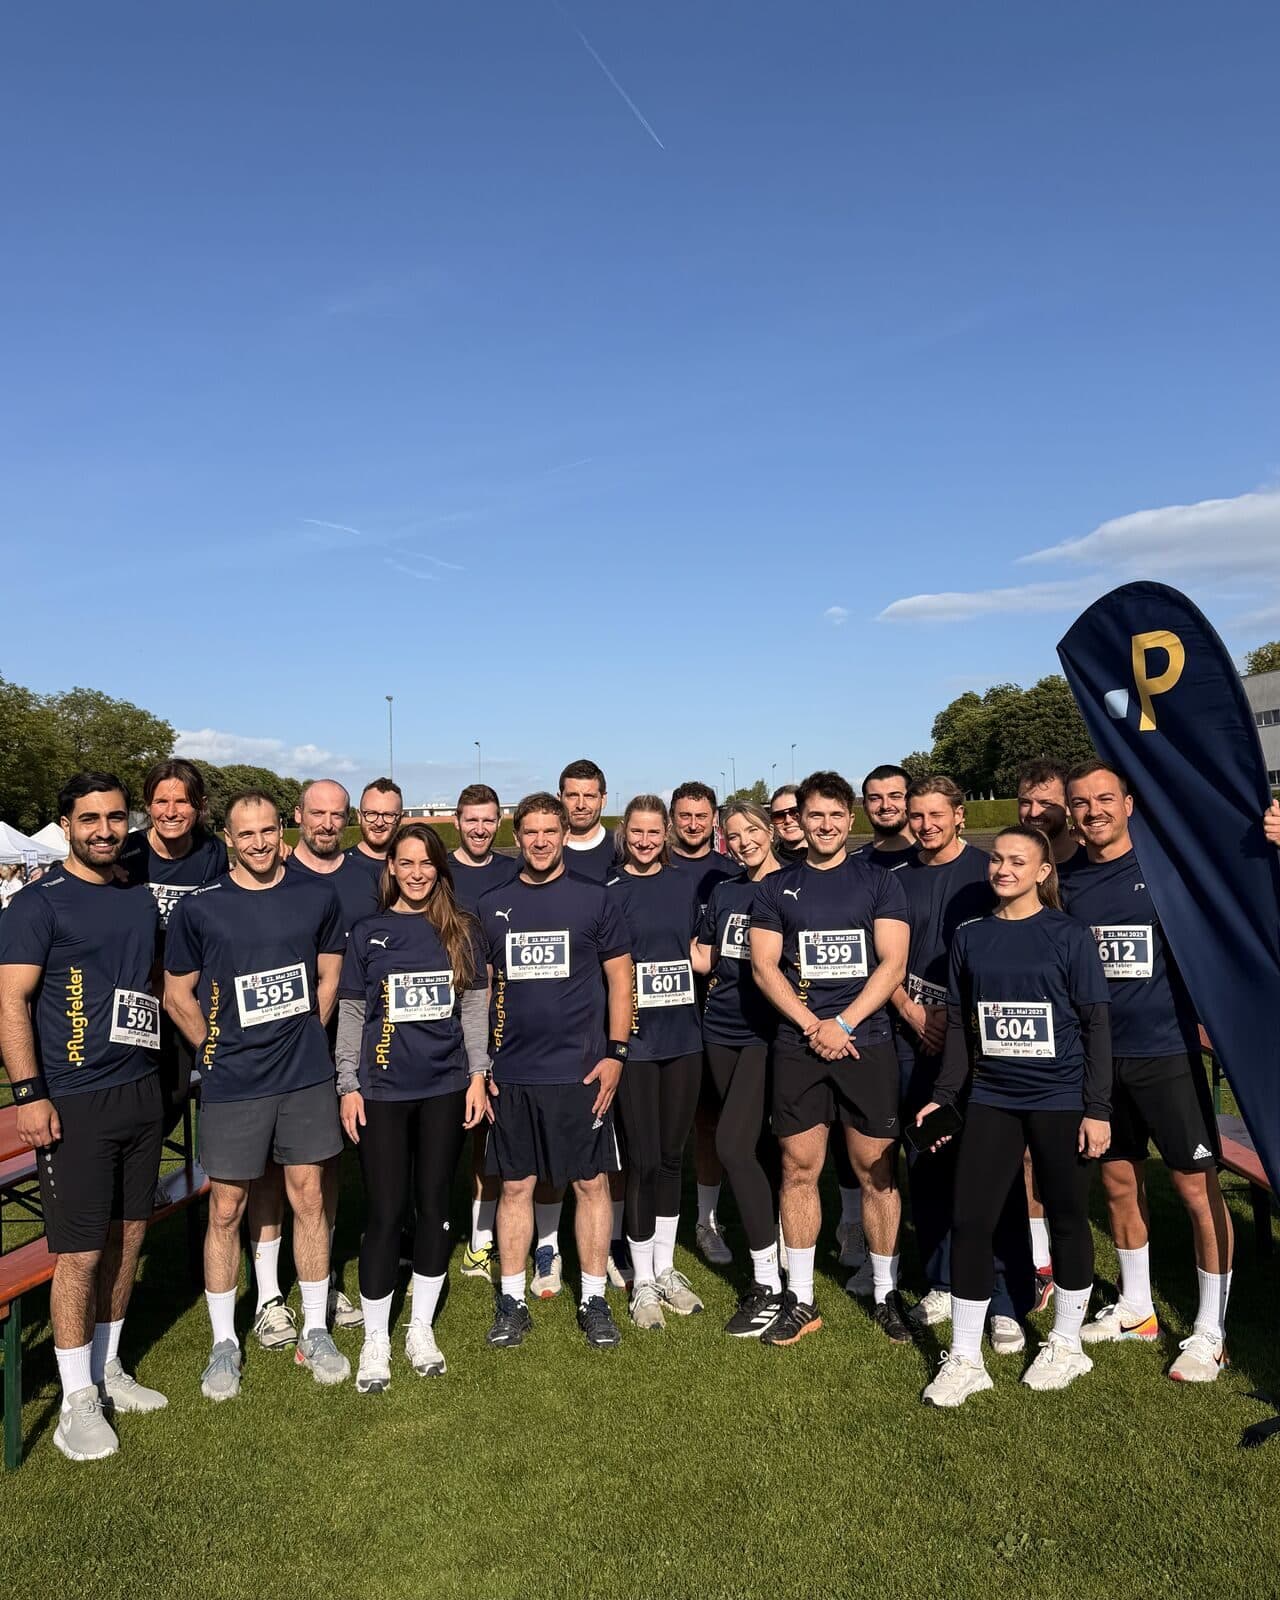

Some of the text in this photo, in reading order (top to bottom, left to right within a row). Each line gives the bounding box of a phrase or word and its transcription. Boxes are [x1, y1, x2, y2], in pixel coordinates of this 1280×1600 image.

[520, 945, 555, 965] 605
[816, 944, 852, 964] 599
[1098, 941, 1136, 962] 612
[652, 974, 681, 993] 601
[256, 981, 294, 1008] 595
[126, 1007, 153, 1031] 592
[995, 1018, 1037, 1040] 604
